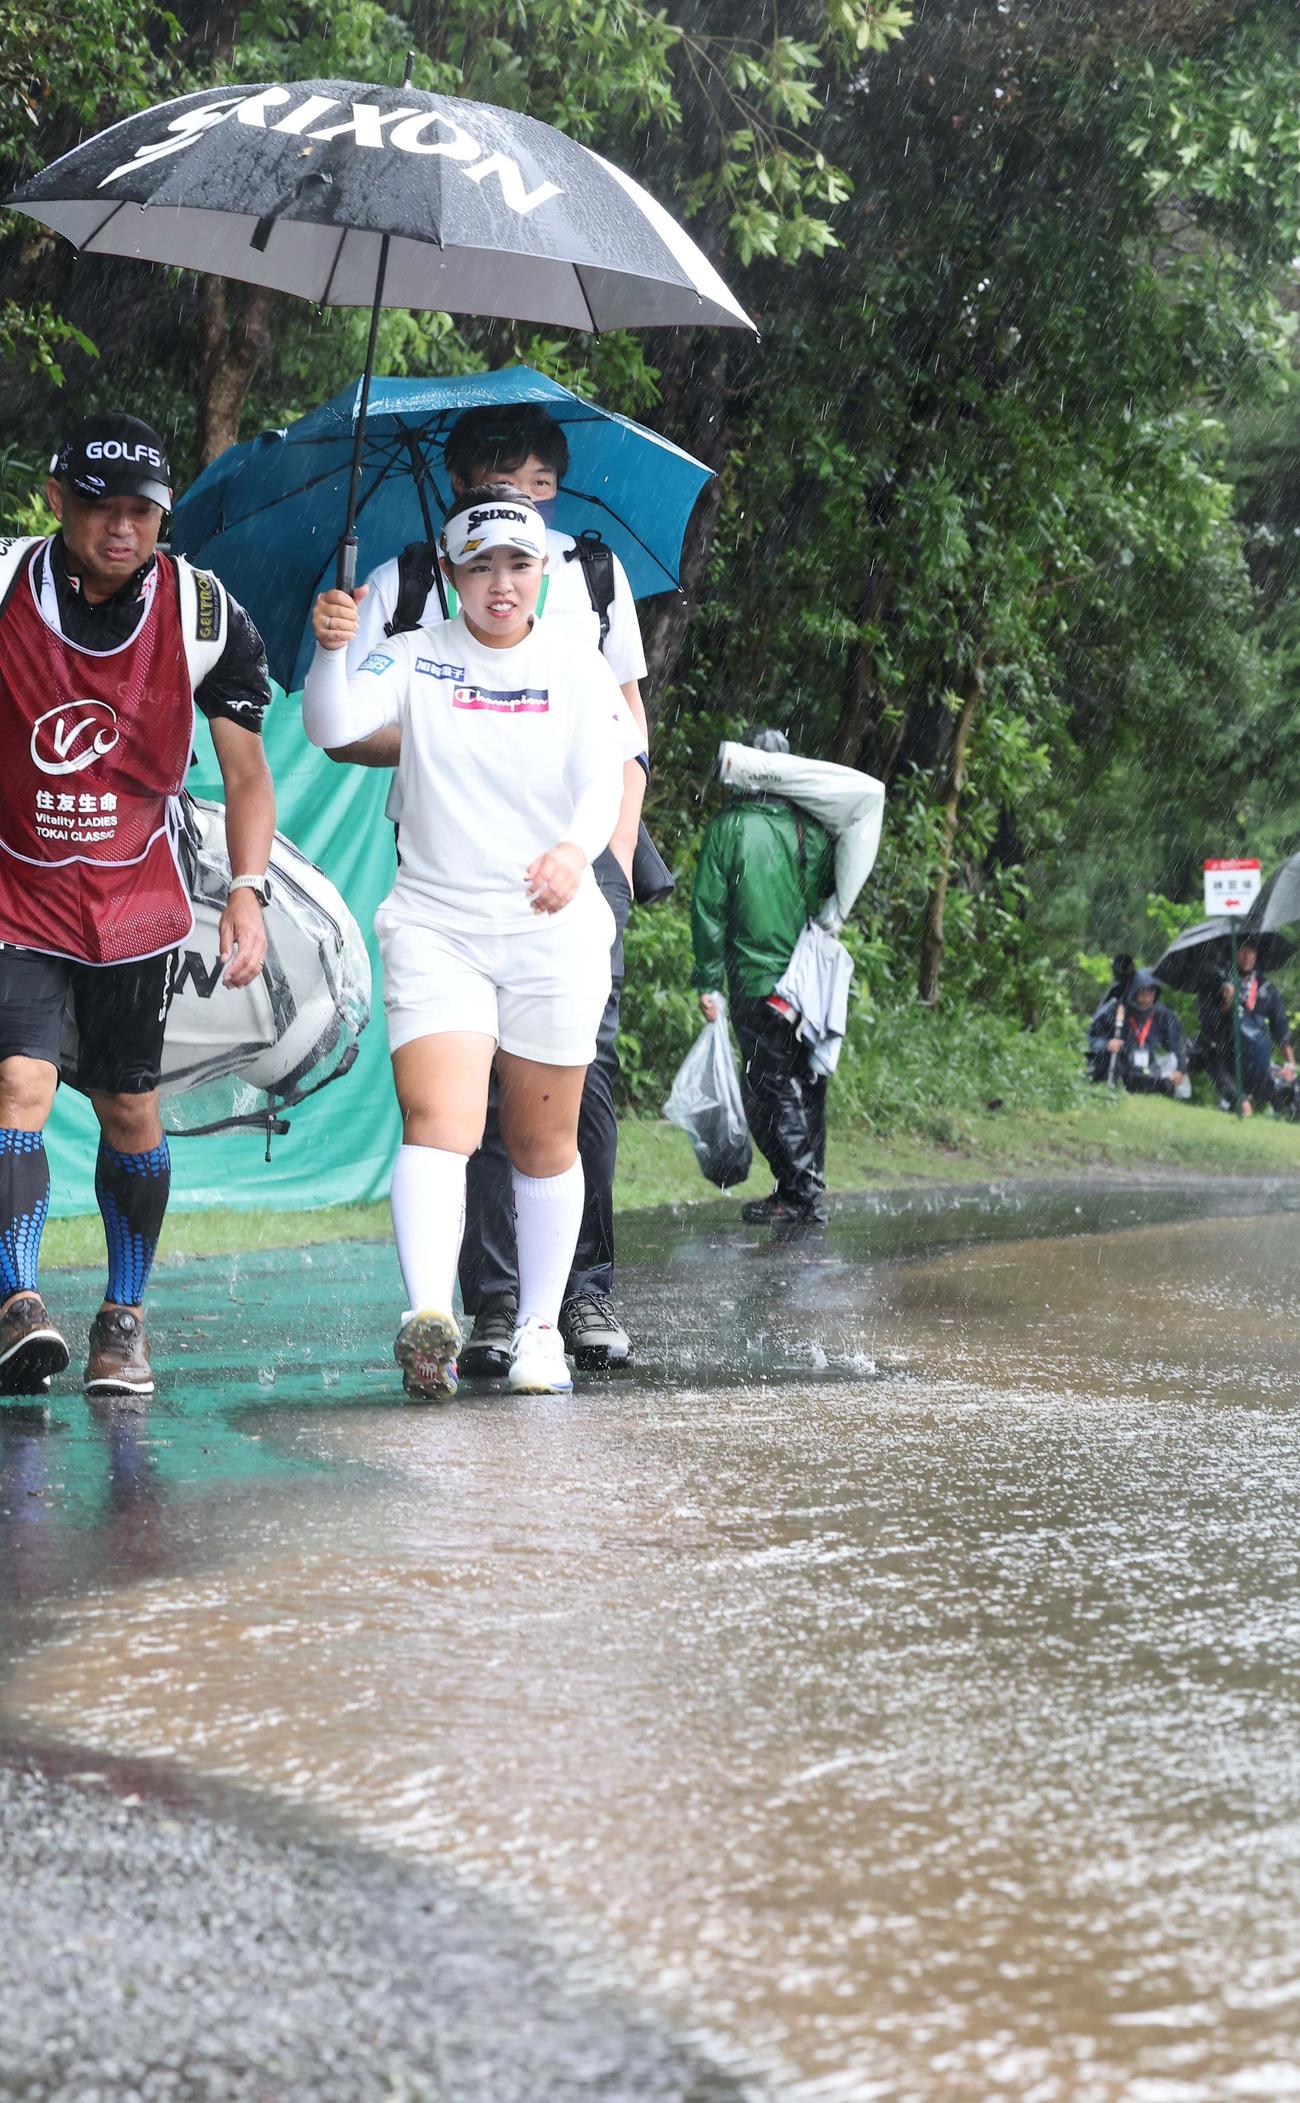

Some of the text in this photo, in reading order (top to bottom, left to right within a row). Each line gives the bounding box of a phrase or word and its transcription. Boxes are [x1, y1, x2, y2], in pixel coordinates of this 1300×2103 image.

[96, 86, 565, 215] SRIXON
[86, 441, 161, 467] GOLF5
[467, 509, 527, 535] SRIXON
[36, 790, 117, 812] 住友生命
[36, 812, 118, 828] Vitality LADIES
[36, 826, 115, 842] TOKAI CLASSIC
